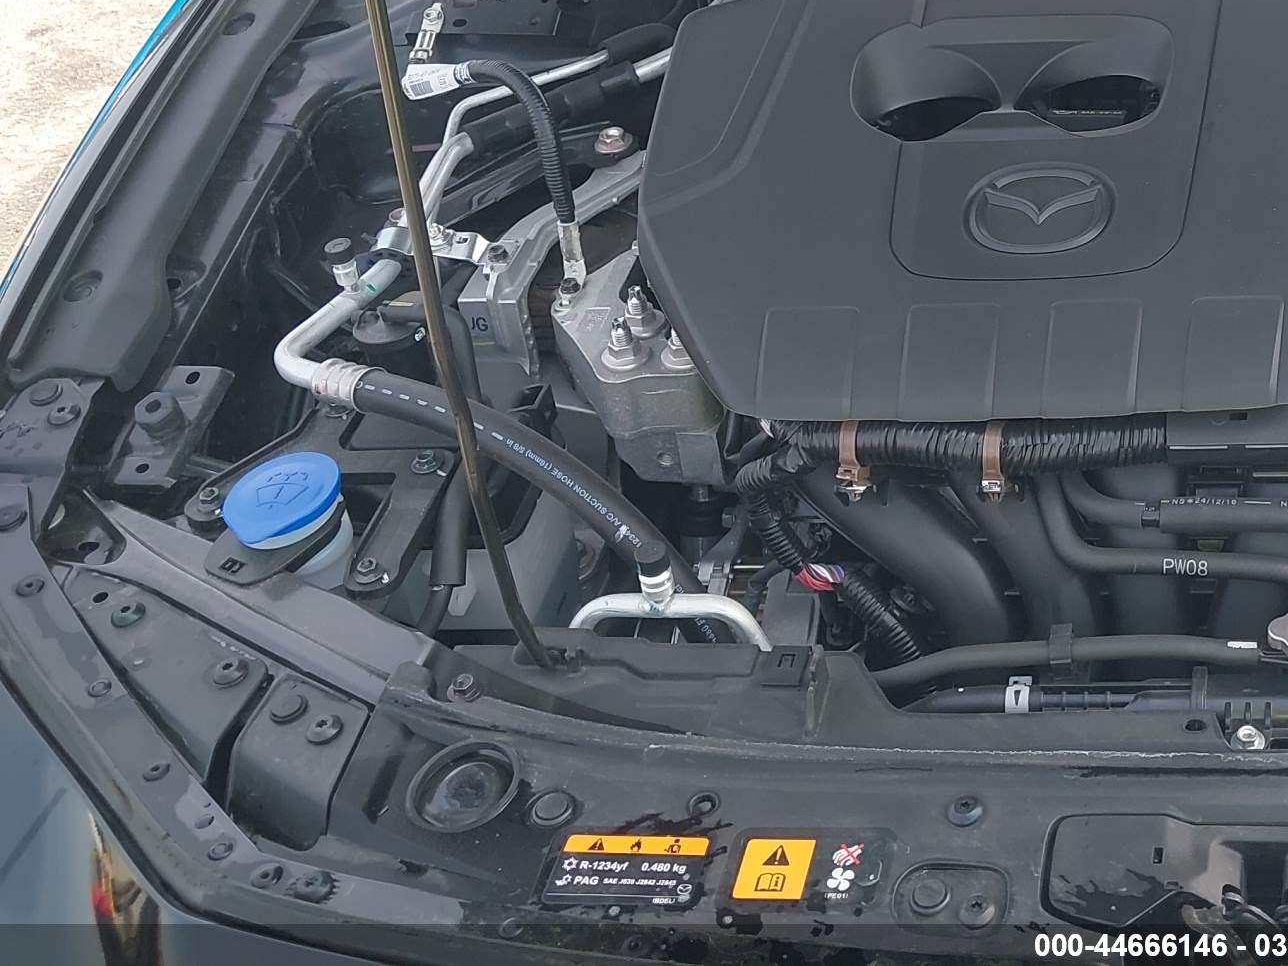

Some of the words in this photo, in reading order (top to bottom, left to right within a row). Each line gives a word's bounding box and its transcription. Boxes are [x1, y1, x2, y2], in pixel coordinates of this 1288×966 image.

[550, 467, 574, 490] HOSE
[573, 484, 608, 515] SUCTION
[606, 511, 622, 527] A/C
[1163, 558, 1208, 577] PW08
[579, 860, 629, 873] R-1234yf
[641, 862, 670, 873] 0.480
[672, 863, 687, 875] kg
[573, 875, 600, 885] PAG
